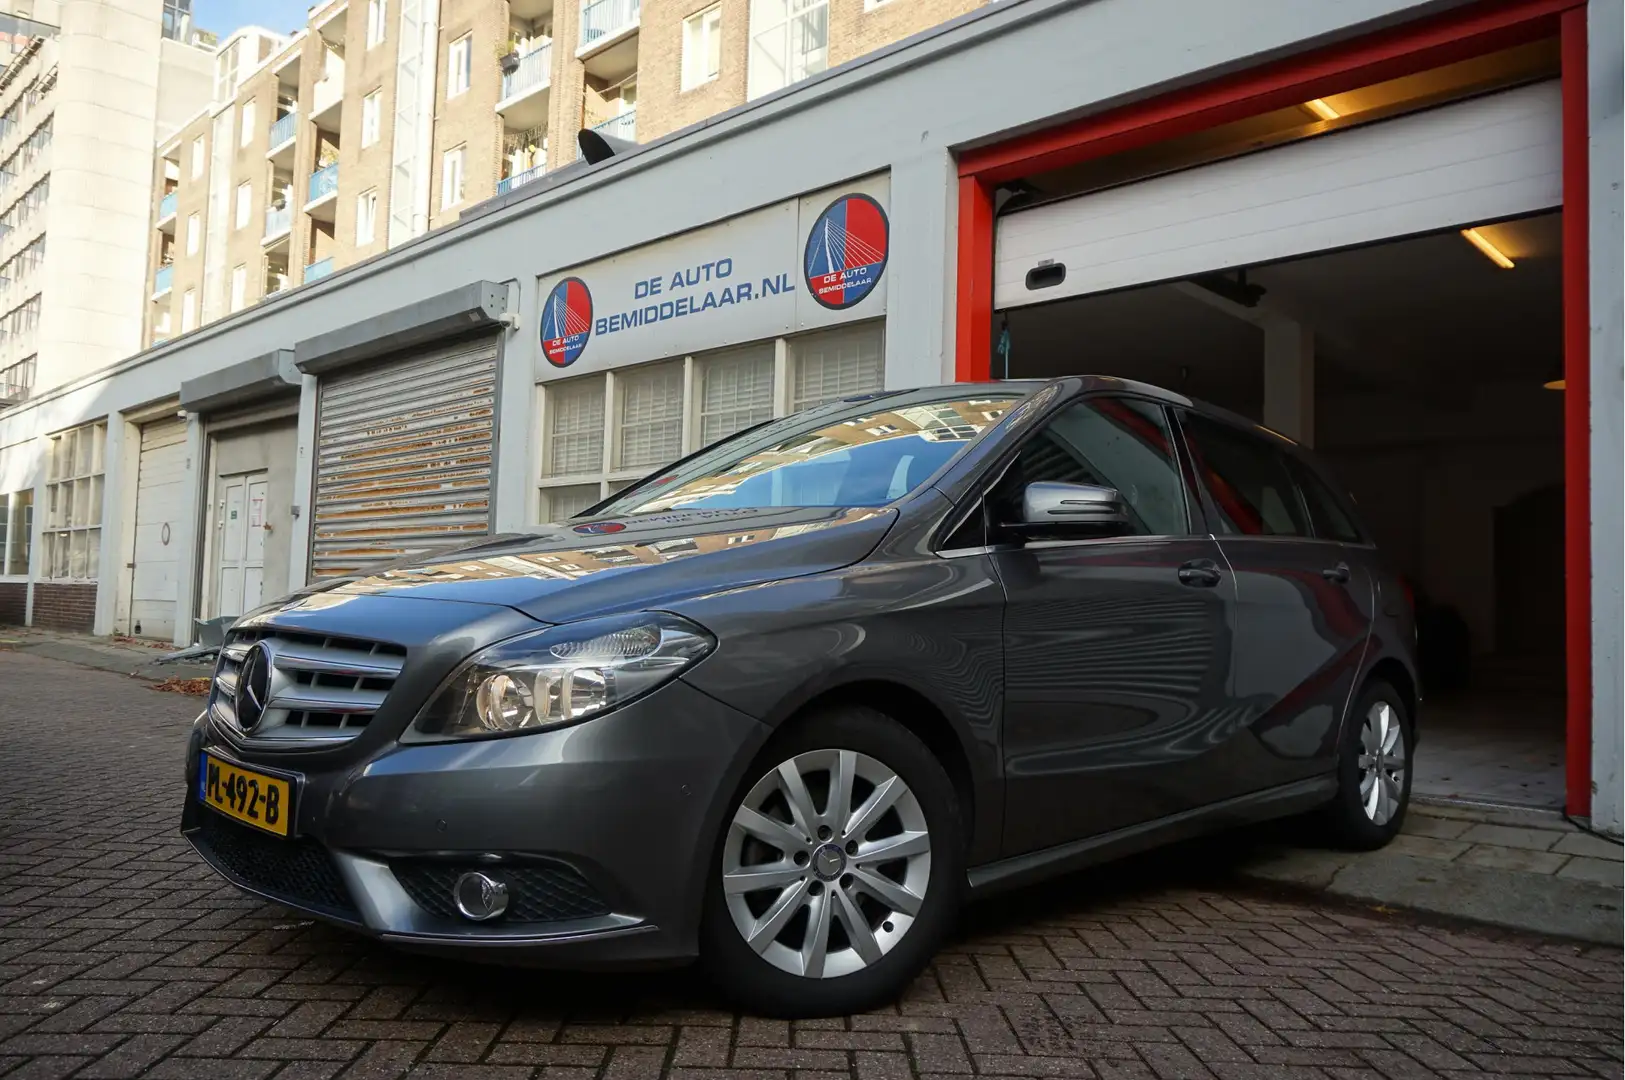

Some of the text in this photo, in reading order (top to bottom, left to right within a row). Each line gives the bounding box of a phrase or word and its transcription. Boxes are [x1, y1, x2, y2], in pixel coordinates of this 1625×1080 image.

[635, 258, 732, 299] DE AUTO
[823, 267, 867, 284] DE AUTO
[818, 277, 872, 294] BEMIDDELAAR
[595, 273, 795, 336] BEMIDDELAAR.NL
[552, 335, 580, 347] DE AUTO
